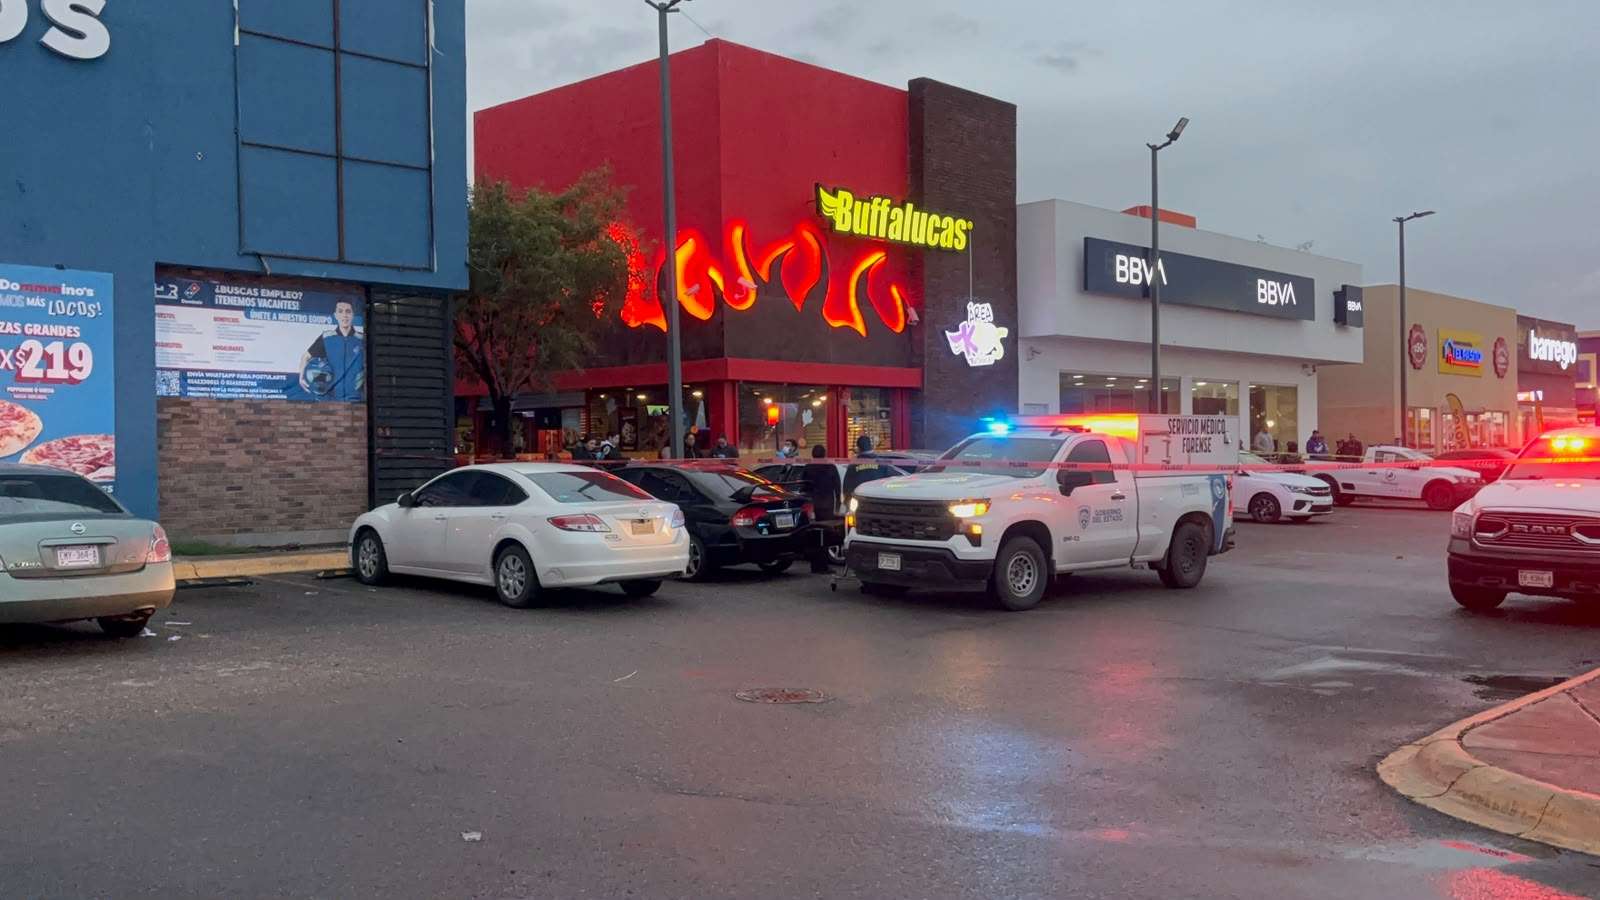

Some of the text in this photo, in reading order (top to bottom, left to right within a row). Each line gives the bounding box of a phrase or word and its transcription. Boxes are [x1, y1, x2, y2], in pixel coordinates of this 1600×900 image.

[835, 190, 967, 250] Buffalucas
[1115, 254, 1167, 286] BBVA
[214, 284, 304, 300] ¿BUSCAS EMPLEO?
[1257, 278, 1296, 306] BBVA
[26, 296, 46, 307] MÁS
[48, 300, 103, 318] LOCOS!
[256, 298, 300, 311] VACANTES!
[1347, 300, 1362, 312] BBVA
[24, 323, 81, 337] GRANDES
[1168, 418, 1199, 434] SERVICIO
[1182, 437, 1212, 453] FORENSE
[1511, 524, 1566, 534] RAM
